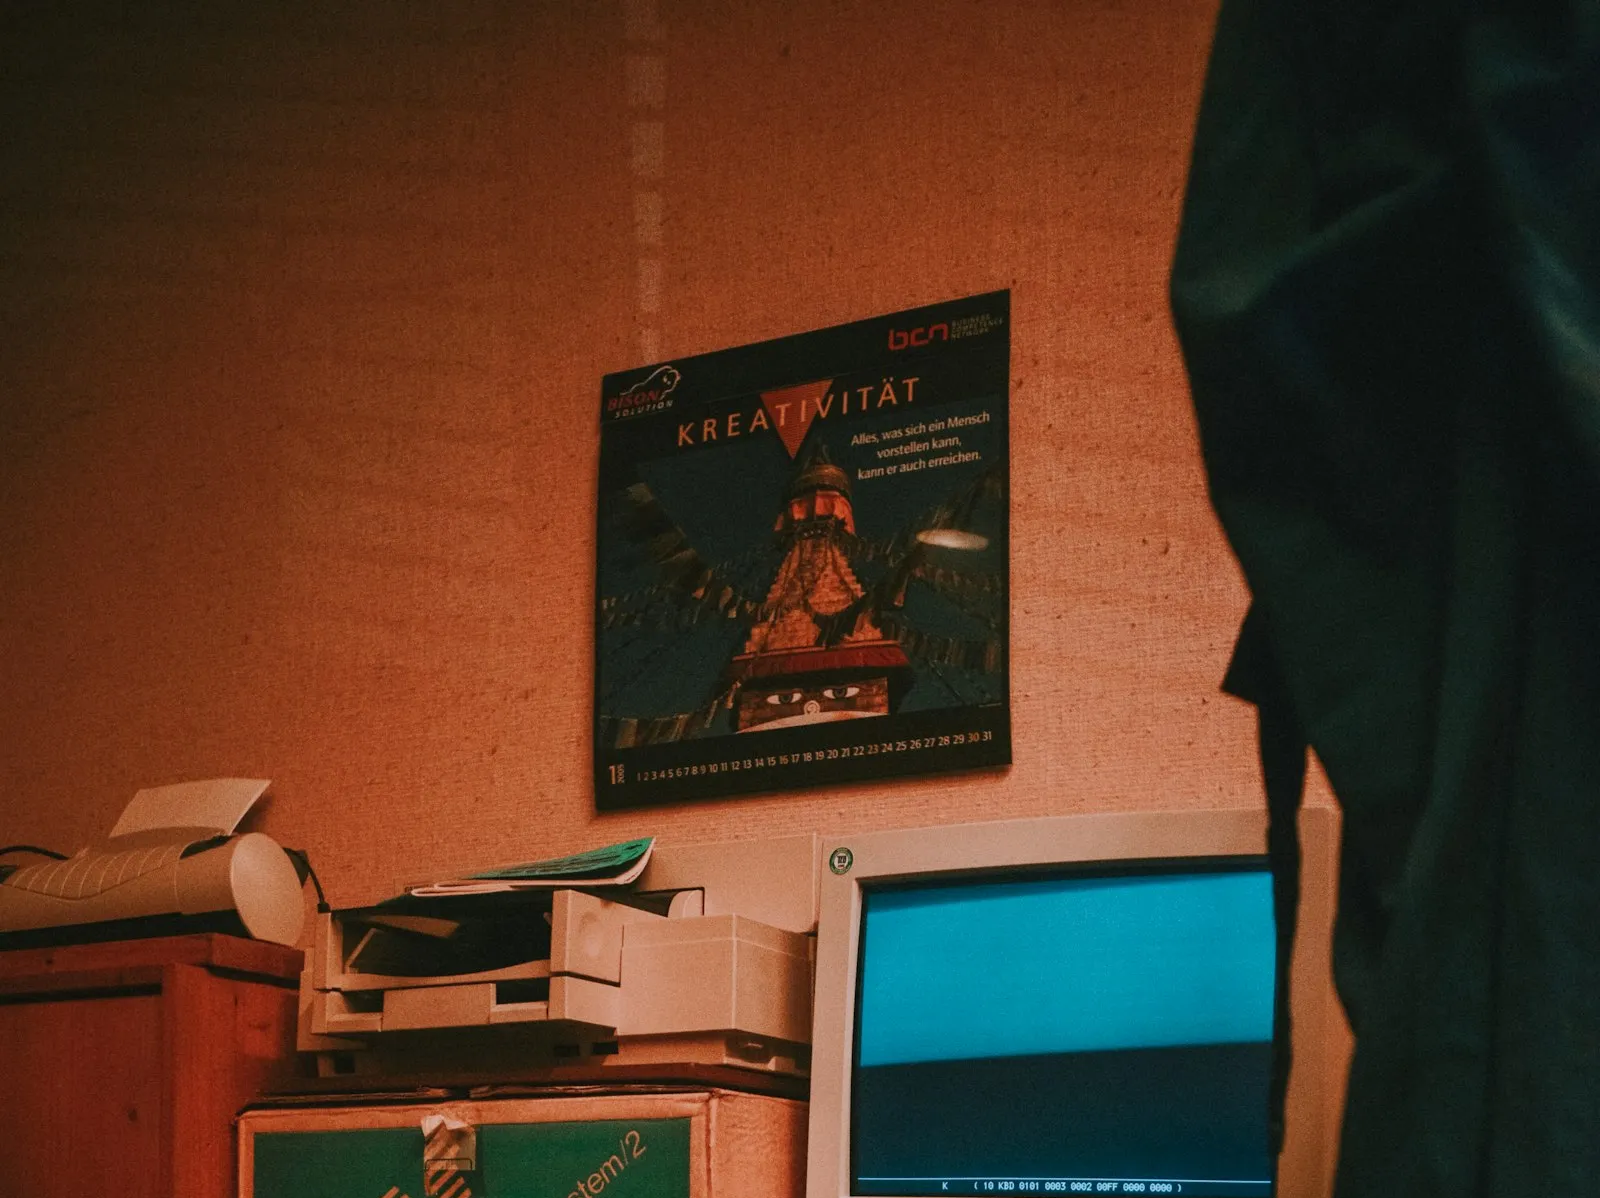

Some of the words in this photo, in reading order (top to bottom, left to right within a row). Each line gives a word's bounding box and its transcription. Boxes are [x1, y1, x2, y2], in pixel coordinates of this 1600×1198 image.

[888, 323, 948, 350] bcn
[614, 400, 674, 419] SOLUTION
[677, 376, 920, 447] KREATIVITÄT
[851, 432, 880, 446] Alles,
[881, 429, 903, 440] was
[904, 422, 926, 436] sich
[928, 419, 945, 432] ein
[947, 411, 990, 429] Mensch
[877, 441, 930, 459] vorstellen
[932, 436, 962, 450] kann,
[857, 467, 885, 480] kann
[886, 465, 897, 475] er
[899, 459, 926, 473] auch
[928, 450, 982, 468] erreichen.
[651, 772, 657, 780] 3
[668, 769, 674, 778] 5
[676, 768, 683, 776] 6
[684, 767, 690, 775] 7
[691, 766, 698, 775] 8
[700, 765, 707, 774] 9
[709, 764, 718, 772] 10
[721, 762, 728, 771] 11
[731, 761, 740, 770] 12
[743, 760, 752, 768] 13
[755, 759, 764, 767] 14
[767, 757, 776, 765] 15
[779, 755, 789, 764] 16
[791, 754, 800, 762] 17
[803, 752, 813, 761] 18
[815, 751, 825, 760] 19
[827, 749, 839, 759] 20
[841, 748, 850, 757] 21
[853, 746, 865, 756] 22
[867, 744, 879, 754] 23
[882, 743, 893, 752] 24
[896, 741, 907, 751] 25
[910, 739, 922, 749] 26
[924, 738, 936, 747] 27
[938, 736, 950, 745] 28
[953, 734, 965, 744] 29
[967, 732, 980, 742] 30
[982, 731, 992, 741] 31
[942, 1181, 949, 1190] K
[983, 1181, 995, 1190] 10
[998, 1181, 1015, 1191] KBD
[1018, 1181, 1040, 1191] 0101
[1044, 1182, 1067, 1191] 0003
[1070, 1182, 1093, 1192] 0002
[1096, 1182, 1118, 1192] 00FF
[1122, 1183, 1146, 1192] 0000
[1150, 1183, 1173, 1192] 0000
